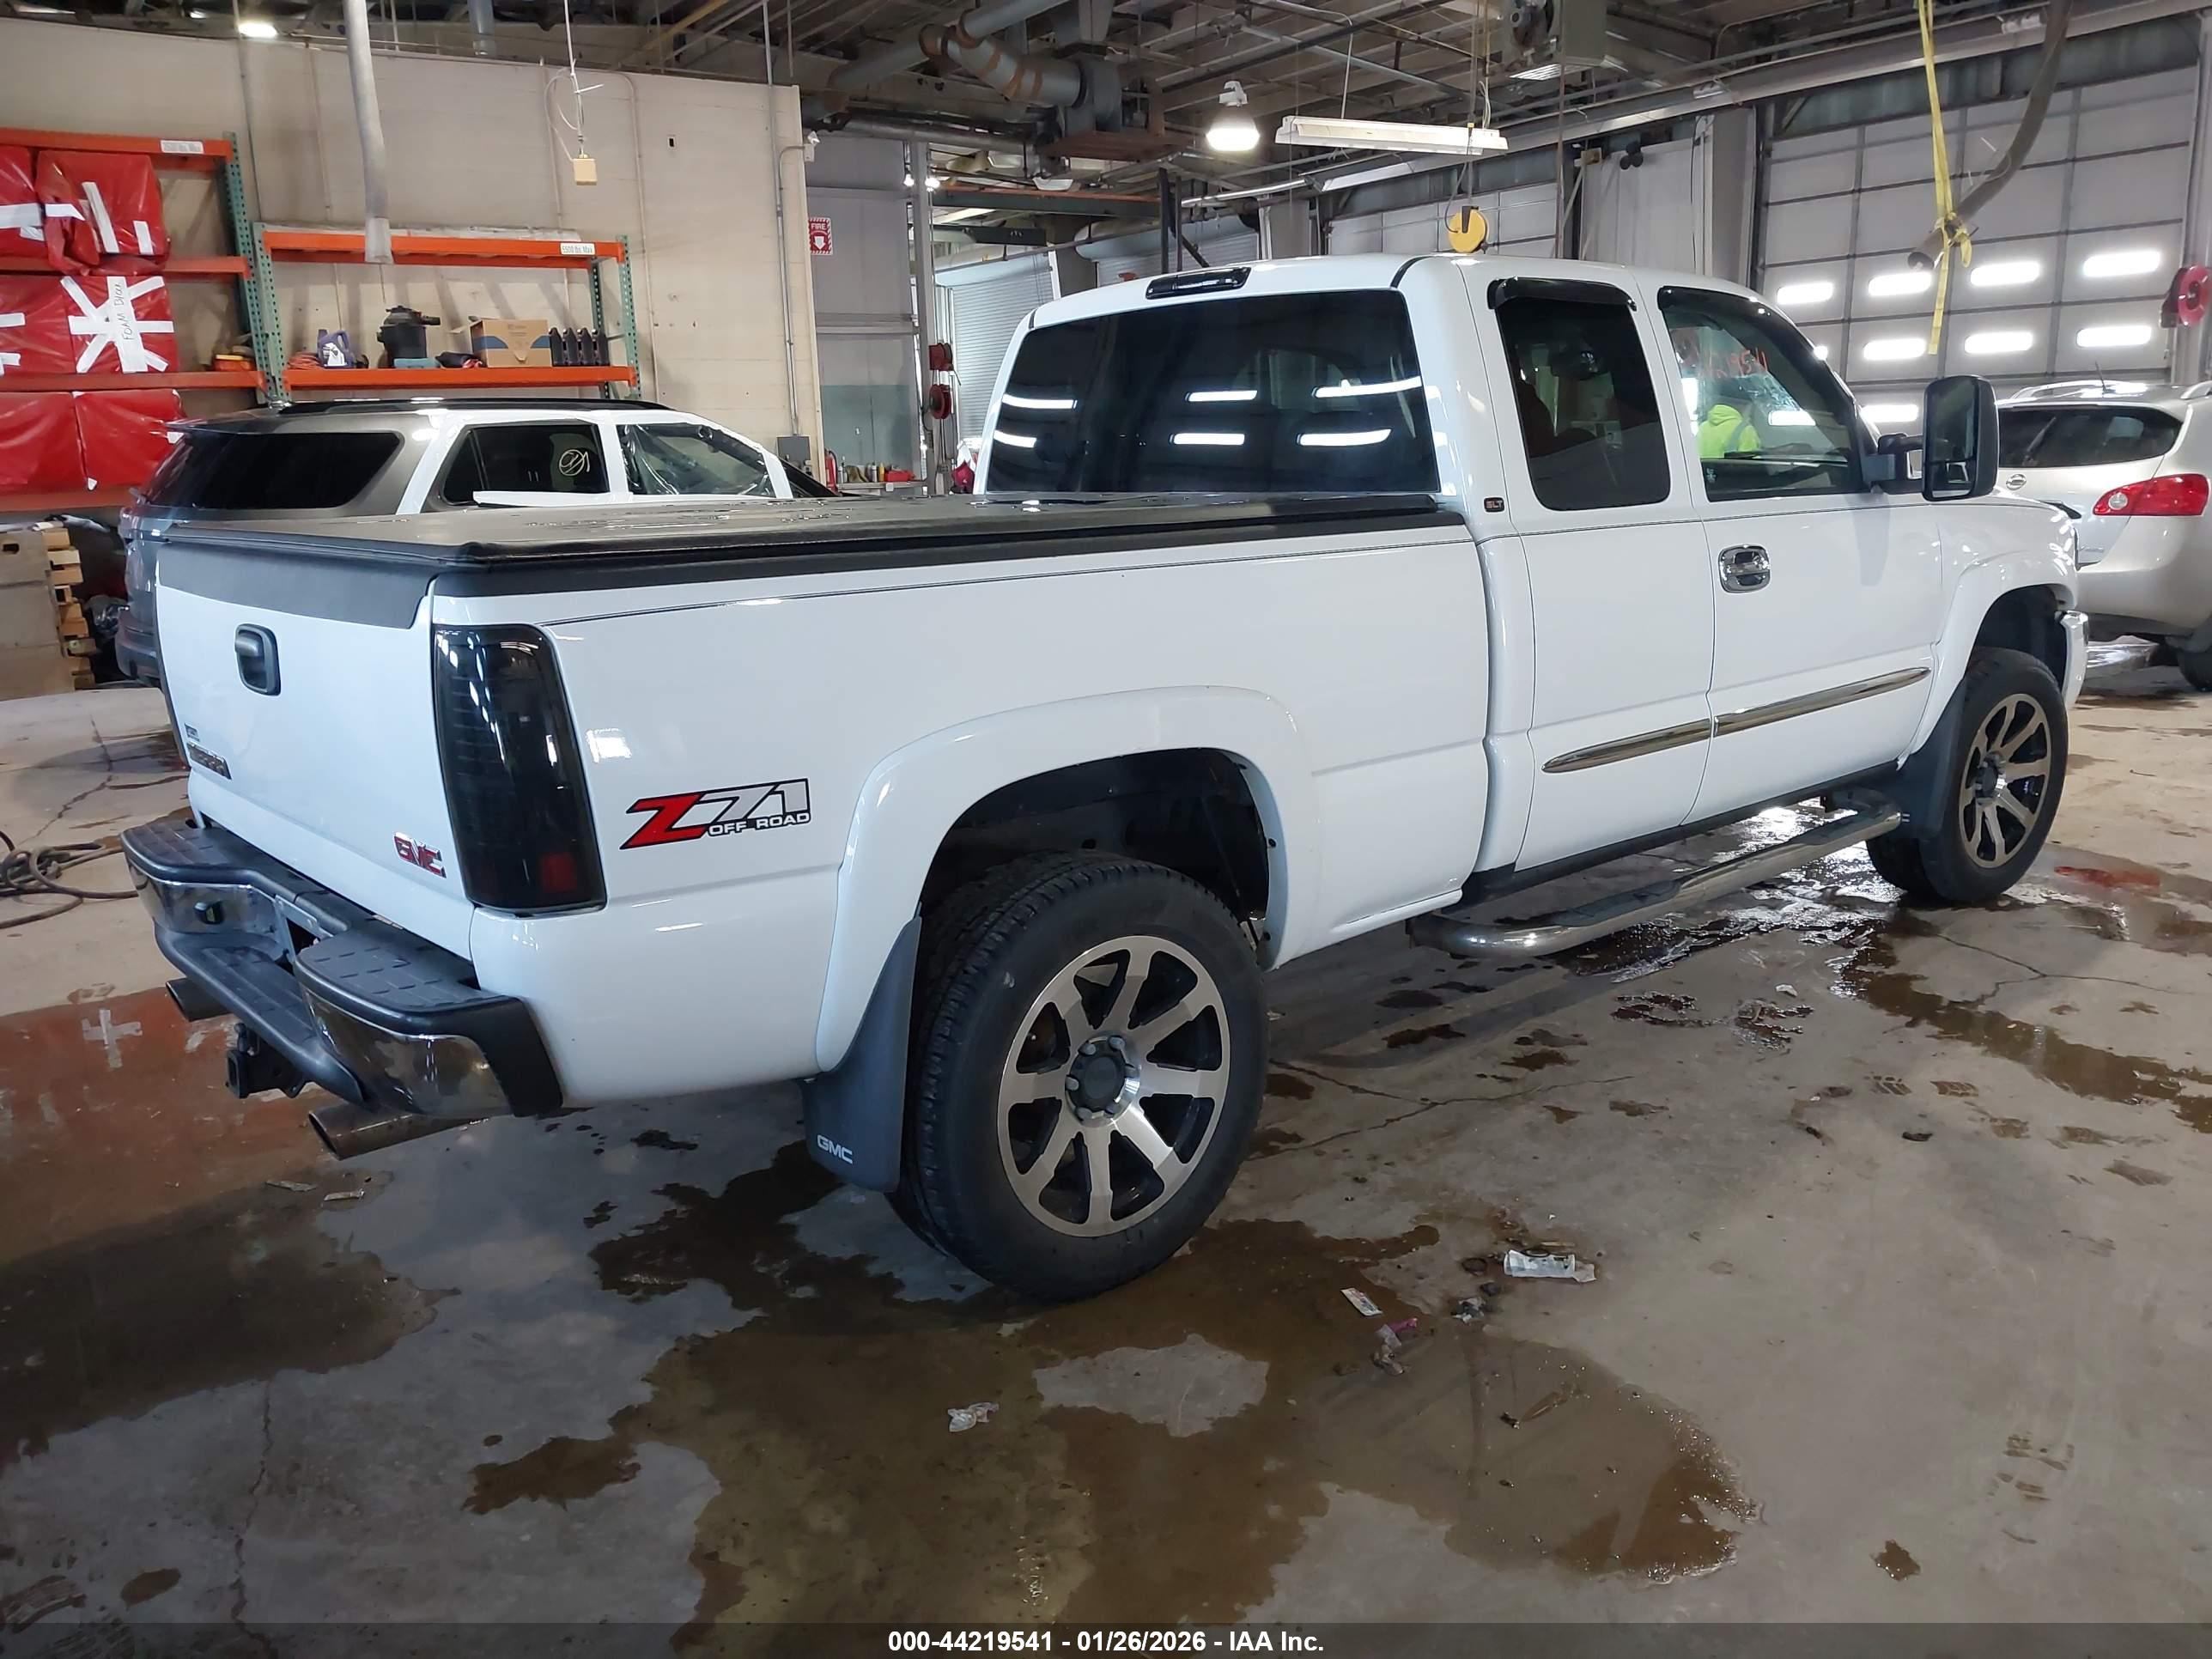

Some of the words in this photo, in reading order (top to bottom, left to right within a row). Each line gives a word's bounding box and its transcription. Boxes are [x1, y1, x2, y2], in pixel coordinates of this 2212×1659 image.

[117, 313, 135, 340] FOAM
[619, 778, 811, 850] Z71
[708, 821, 747, 836] OFF
[757, 812, 811, 829] ROAD
[393, 832, 447, 878] GMC
[817, 1134, 854, 1164] GMC
